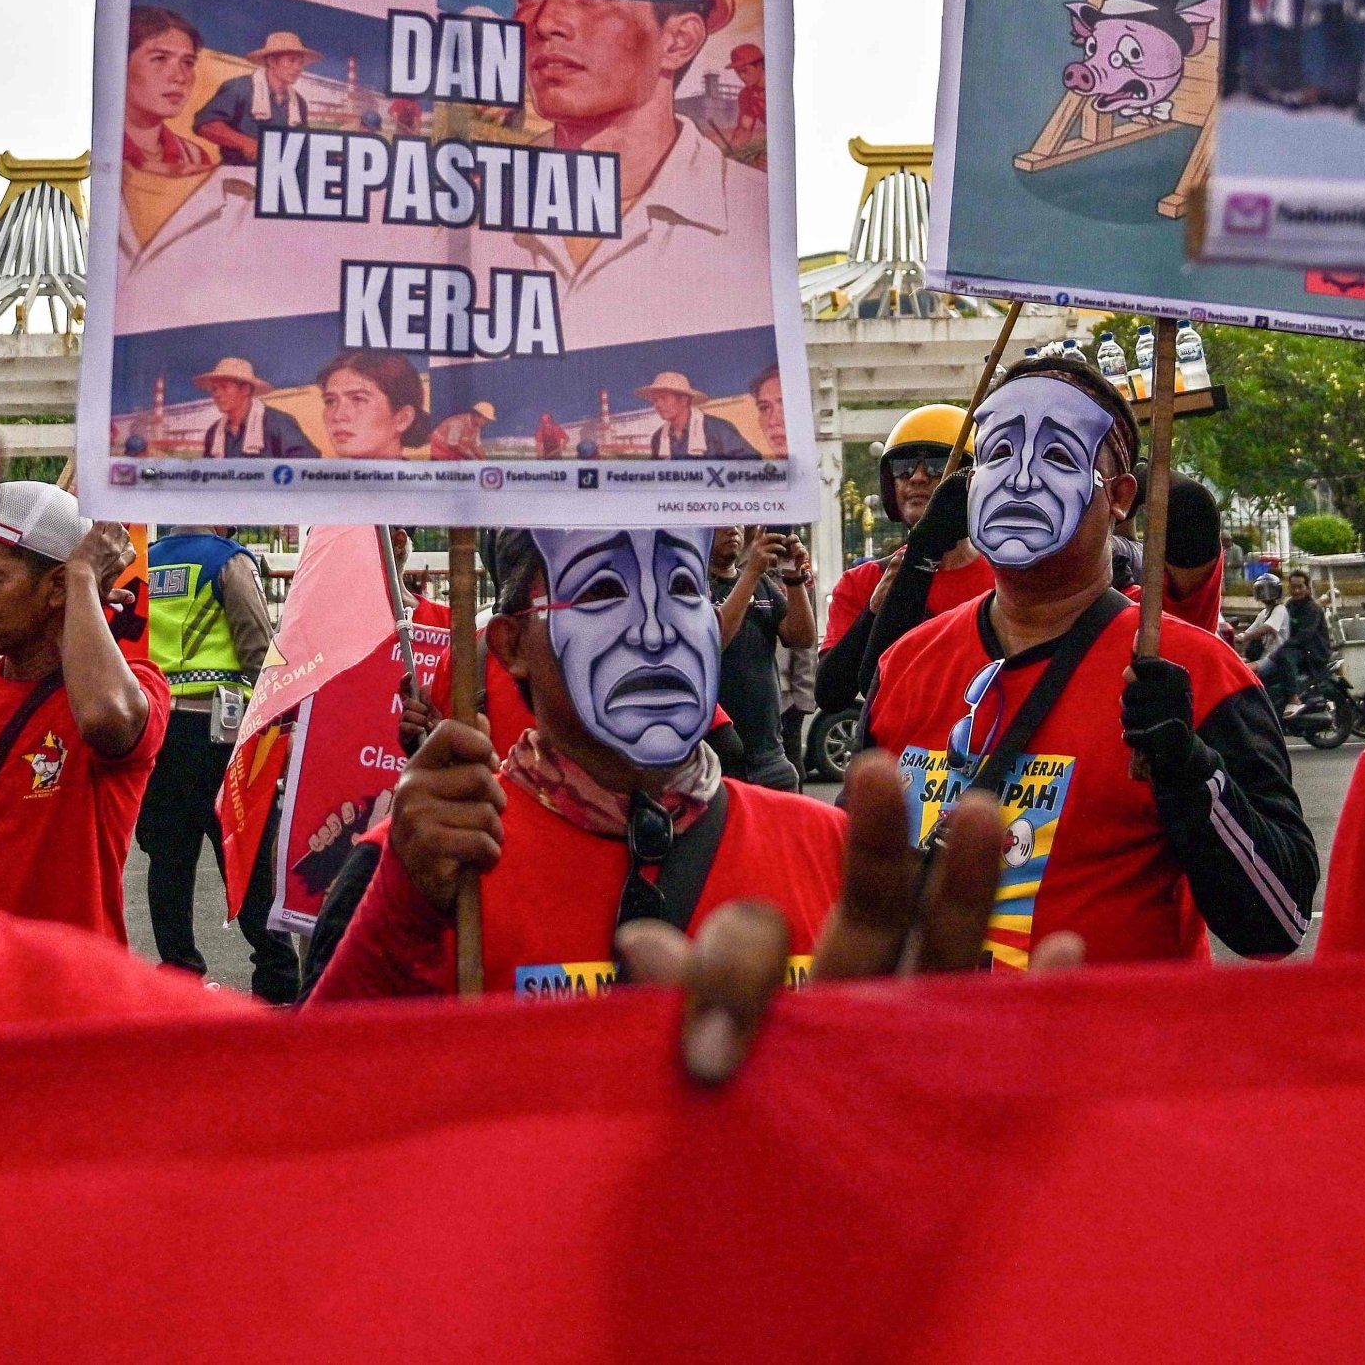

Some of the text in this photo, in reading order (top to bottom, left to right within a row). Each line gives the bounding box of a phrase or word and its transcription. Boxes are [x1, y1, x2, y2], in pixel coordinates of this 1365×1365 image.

[387, 11, 524, 104] DAN
[257, 125, 620, 236] KEPASTIAN
[340, 262, 562, 356] KERJA
[1074, 296, 1107, 308] Federasi
[1108, 301, 1135, 311] Serikat
[1136, 303, 1161, 314] Buruh
[301, 470, 350, 481] Federasi
[354, 470, 394, 481] Serikat
[397, 471, 432, 481] Buruh
[435, 471, 476, 482] Militan
[506, 470, 567, 482] fsebumi19
[607, 471, 655, 482] Federasi
[657, 471, 703, 482] SEBUMI
[658, 502, 785, 512] HAKI 50X70 POLOS C1X
[412, 628, 451, 646] own
[901, 752, 936, 771] SAMA
[1021, 760, 1066, 778] KERJA
